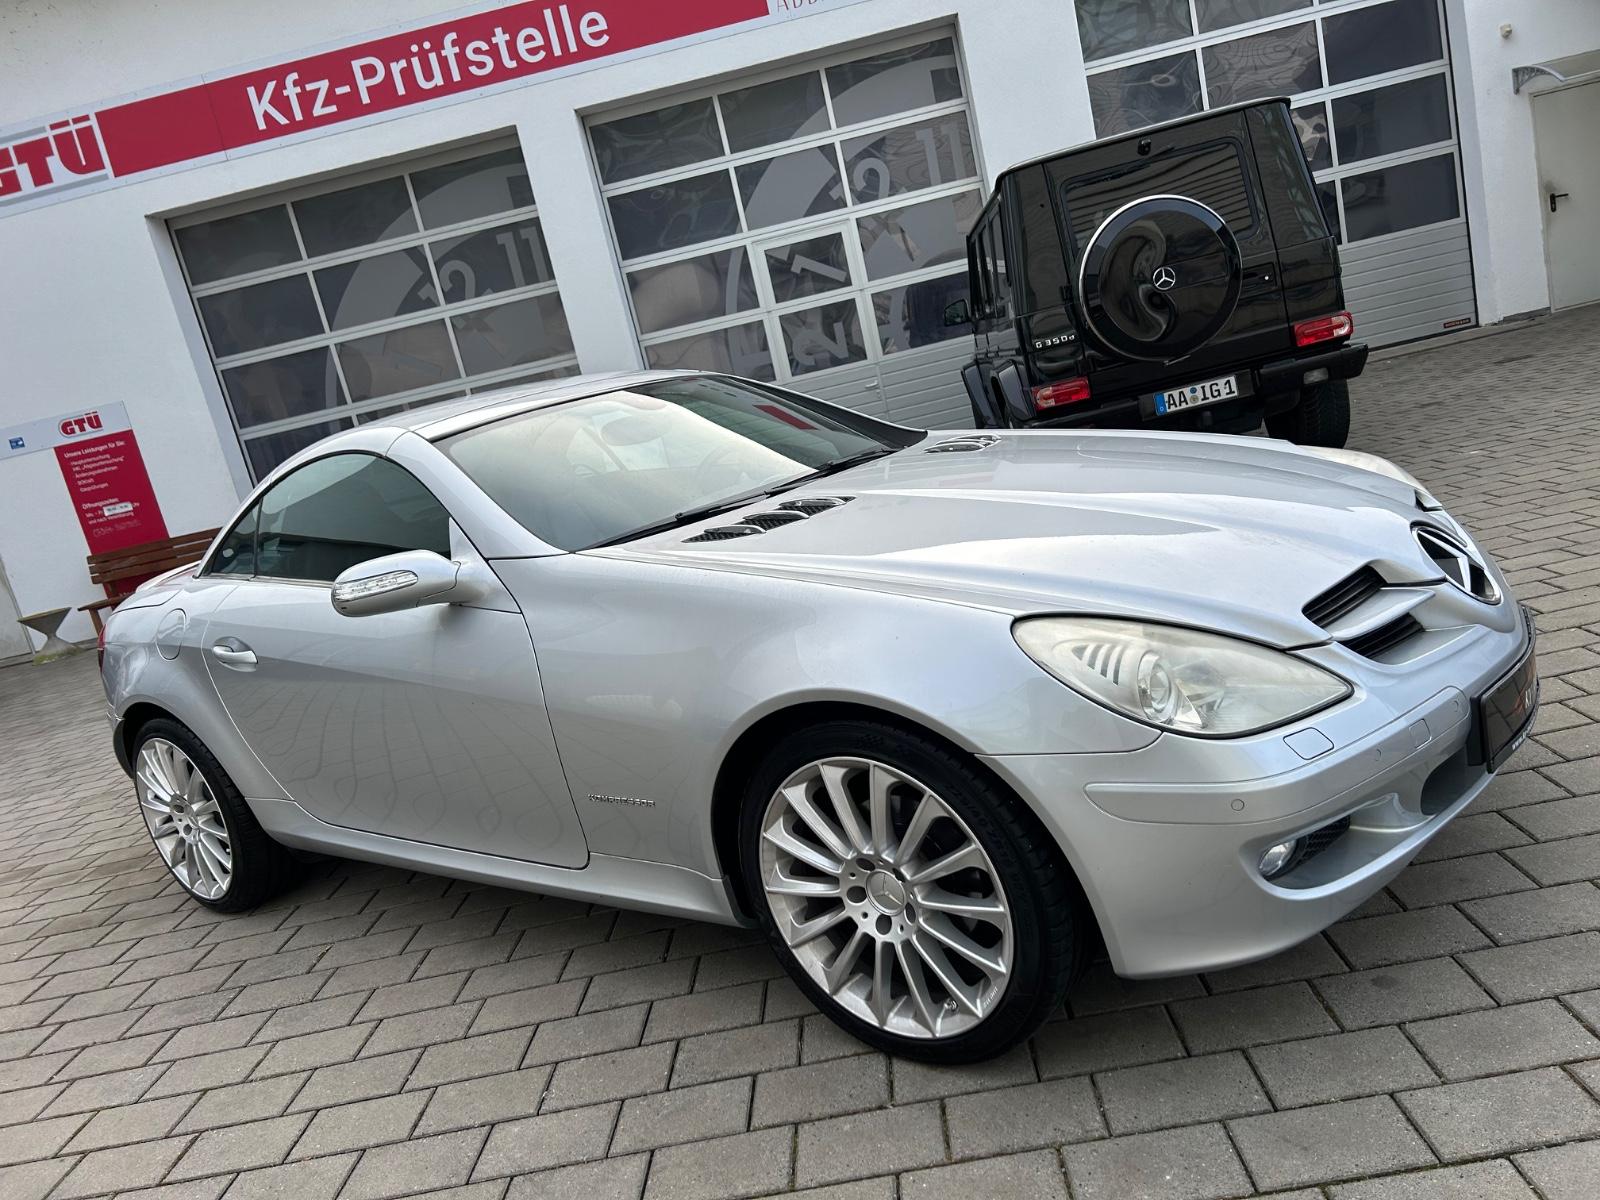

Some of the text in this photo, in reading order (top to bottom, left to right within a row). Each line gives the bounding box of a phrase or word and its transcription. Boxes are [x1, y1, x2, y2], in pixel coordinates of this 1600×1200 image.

[246, 4, 610, 130] Kfz-Prüfstelle
[1167, 390, 1189, 410] AA
[60, 411, 102, 436] GTÜ
